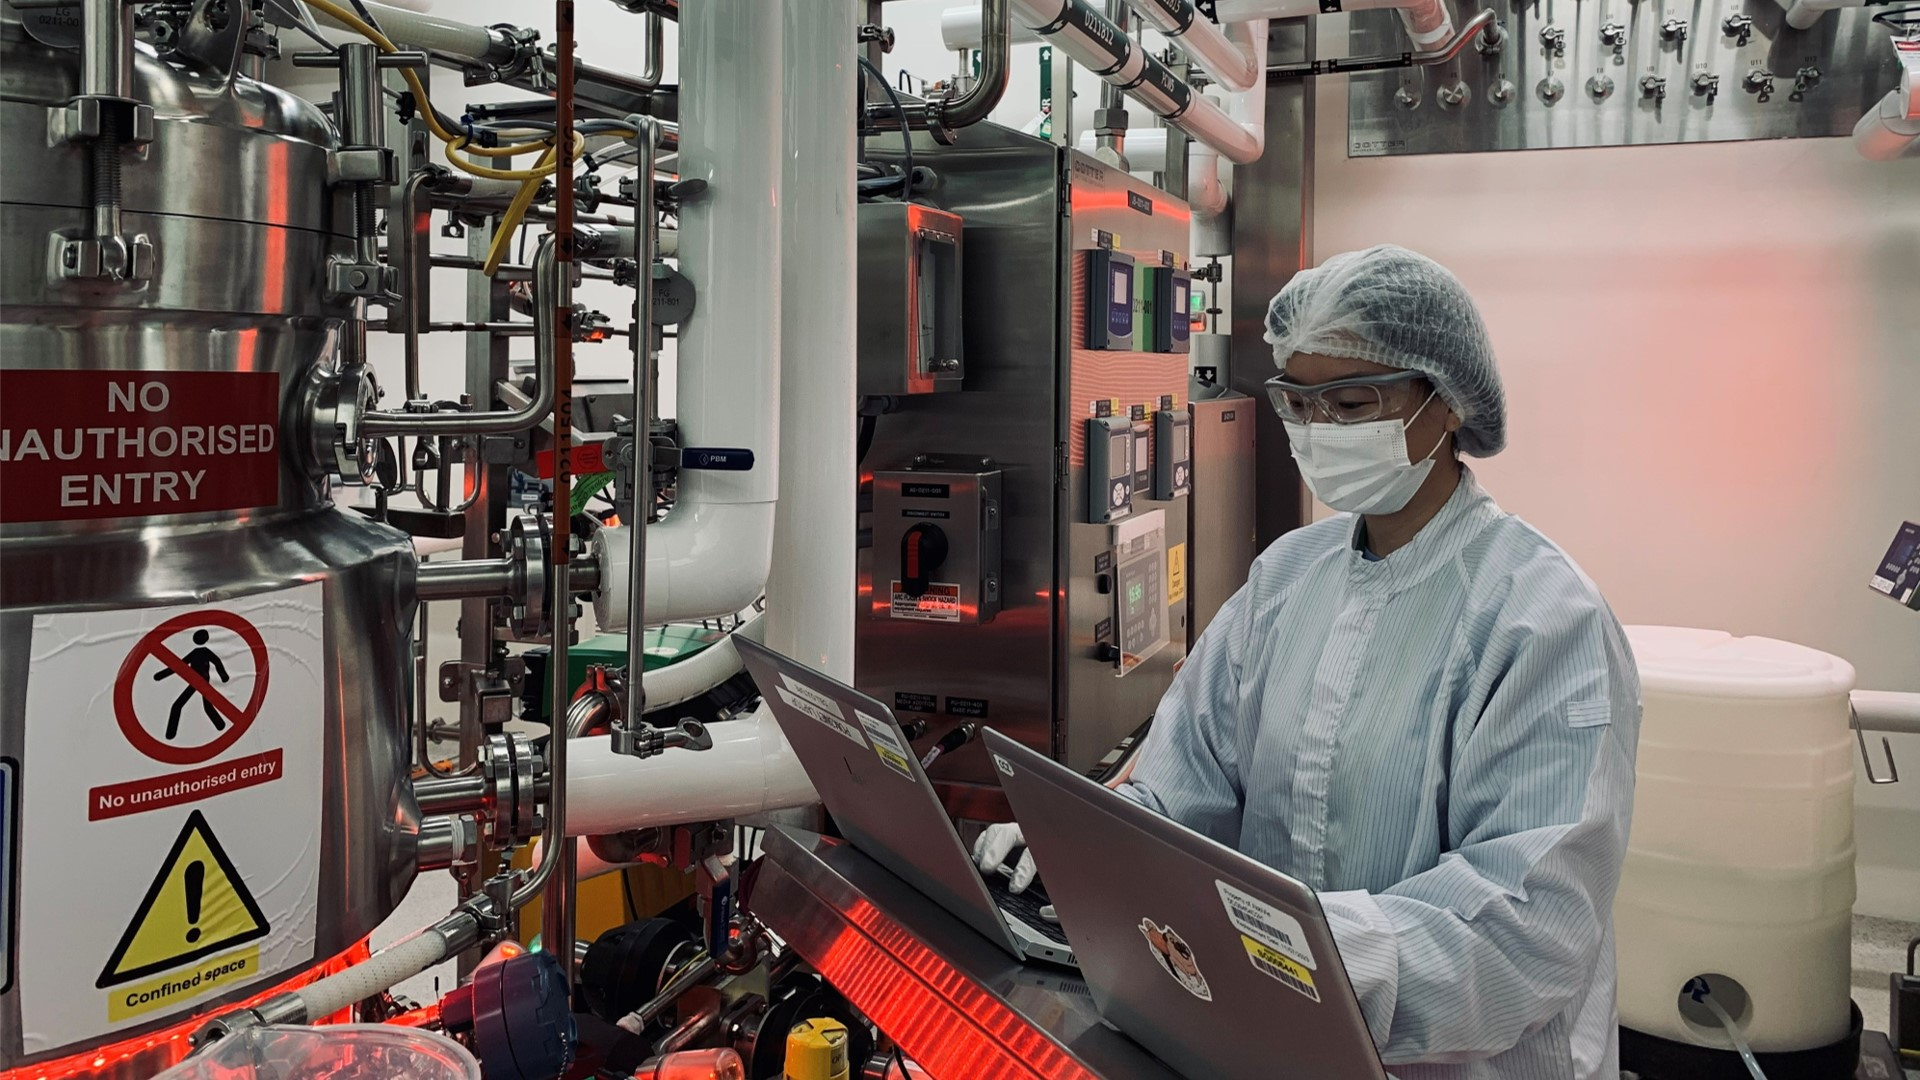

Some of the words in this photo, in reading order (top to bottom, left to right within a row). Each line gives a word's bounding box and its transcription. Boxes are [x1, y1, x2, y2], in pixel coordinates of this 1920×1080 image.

[38, 15, 80, 27] 0211-00
[55, 7, 71, 16] LG
[1084, 9, 1115, 46] 0211812
[1075, 160, 1104, 182] COTTER
[658, 288, 670, 297] FG
[108, 381, 170, 413] NO
[60, 469, 206, 507] ENTRY
[100, 795, 125, 809] No
[130, 768, 237, 804] unauthorised
[240, 761, 276, 779] entry
[126, 972, 201, 1007] Confined
[204, 959, 246, 981] space
